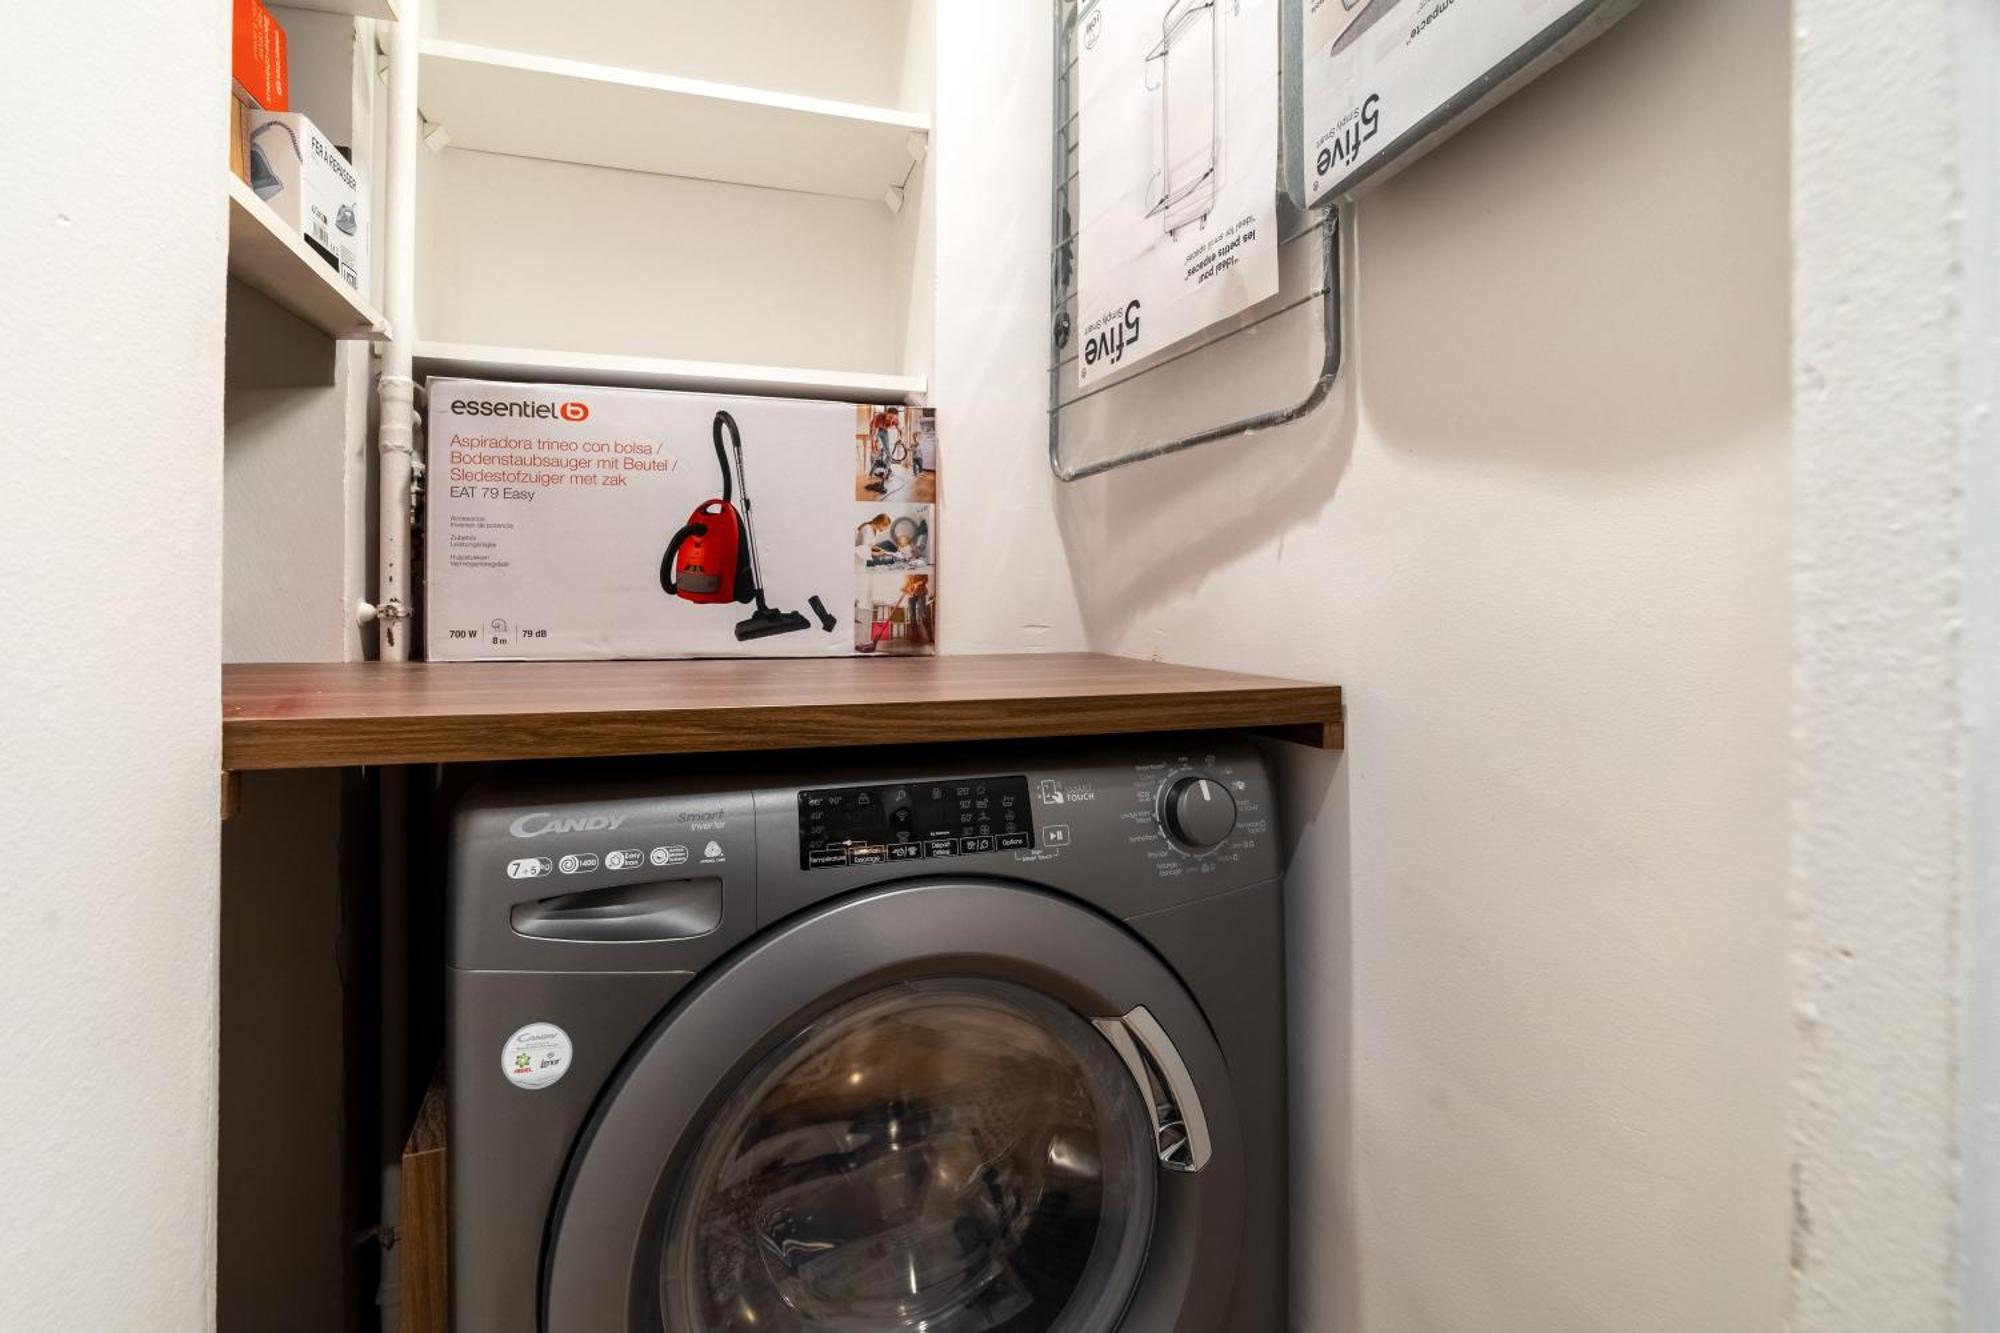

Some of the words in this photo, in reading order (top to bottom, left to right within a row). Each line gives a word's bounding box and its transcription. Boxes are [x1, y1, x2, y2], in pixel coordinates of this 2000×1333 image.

[311, 136, 324, 159] FER
[328, 154, 356, 192] REPASSER
[1242, 229, 1256, 243] les
[1218, 236, 1241, 257] petits
[1198, 263, 1215, 284] pour
[450, 435, 533, 451] Aspiradora
[537, 438, 578, 452] trineo
[582, 442, 610, 453] con
[614, 441, 653, 454] bolsa
[451, 452, 592, 471] Bodenstaubsauger
[597, 457, 619, 470] mit
[623, 457, 668, 471] Beutel
[450, 468, 564, 487] Sledestofzuiger
[570, 474, 598, 486] met
[601, 474, 627, 486] zak
[450, 487, 477, 498] EAT
[482, 488, 500, 499] 79
[503, 488, 535, 502] Easy
[449, 630, 466, 639] 700
[468, 630, 477, 638] W
[492, 637, 498, 645] 8
[522, 630, 533, 638] 79
[535, 630, 547, 638] dB
[1067, 792, 1095, 802] TOUCH
[677, 807, 725, 823] Smart
[510, 813, 627, 838] CANDY
[624, 852, 640, 860] Easy
